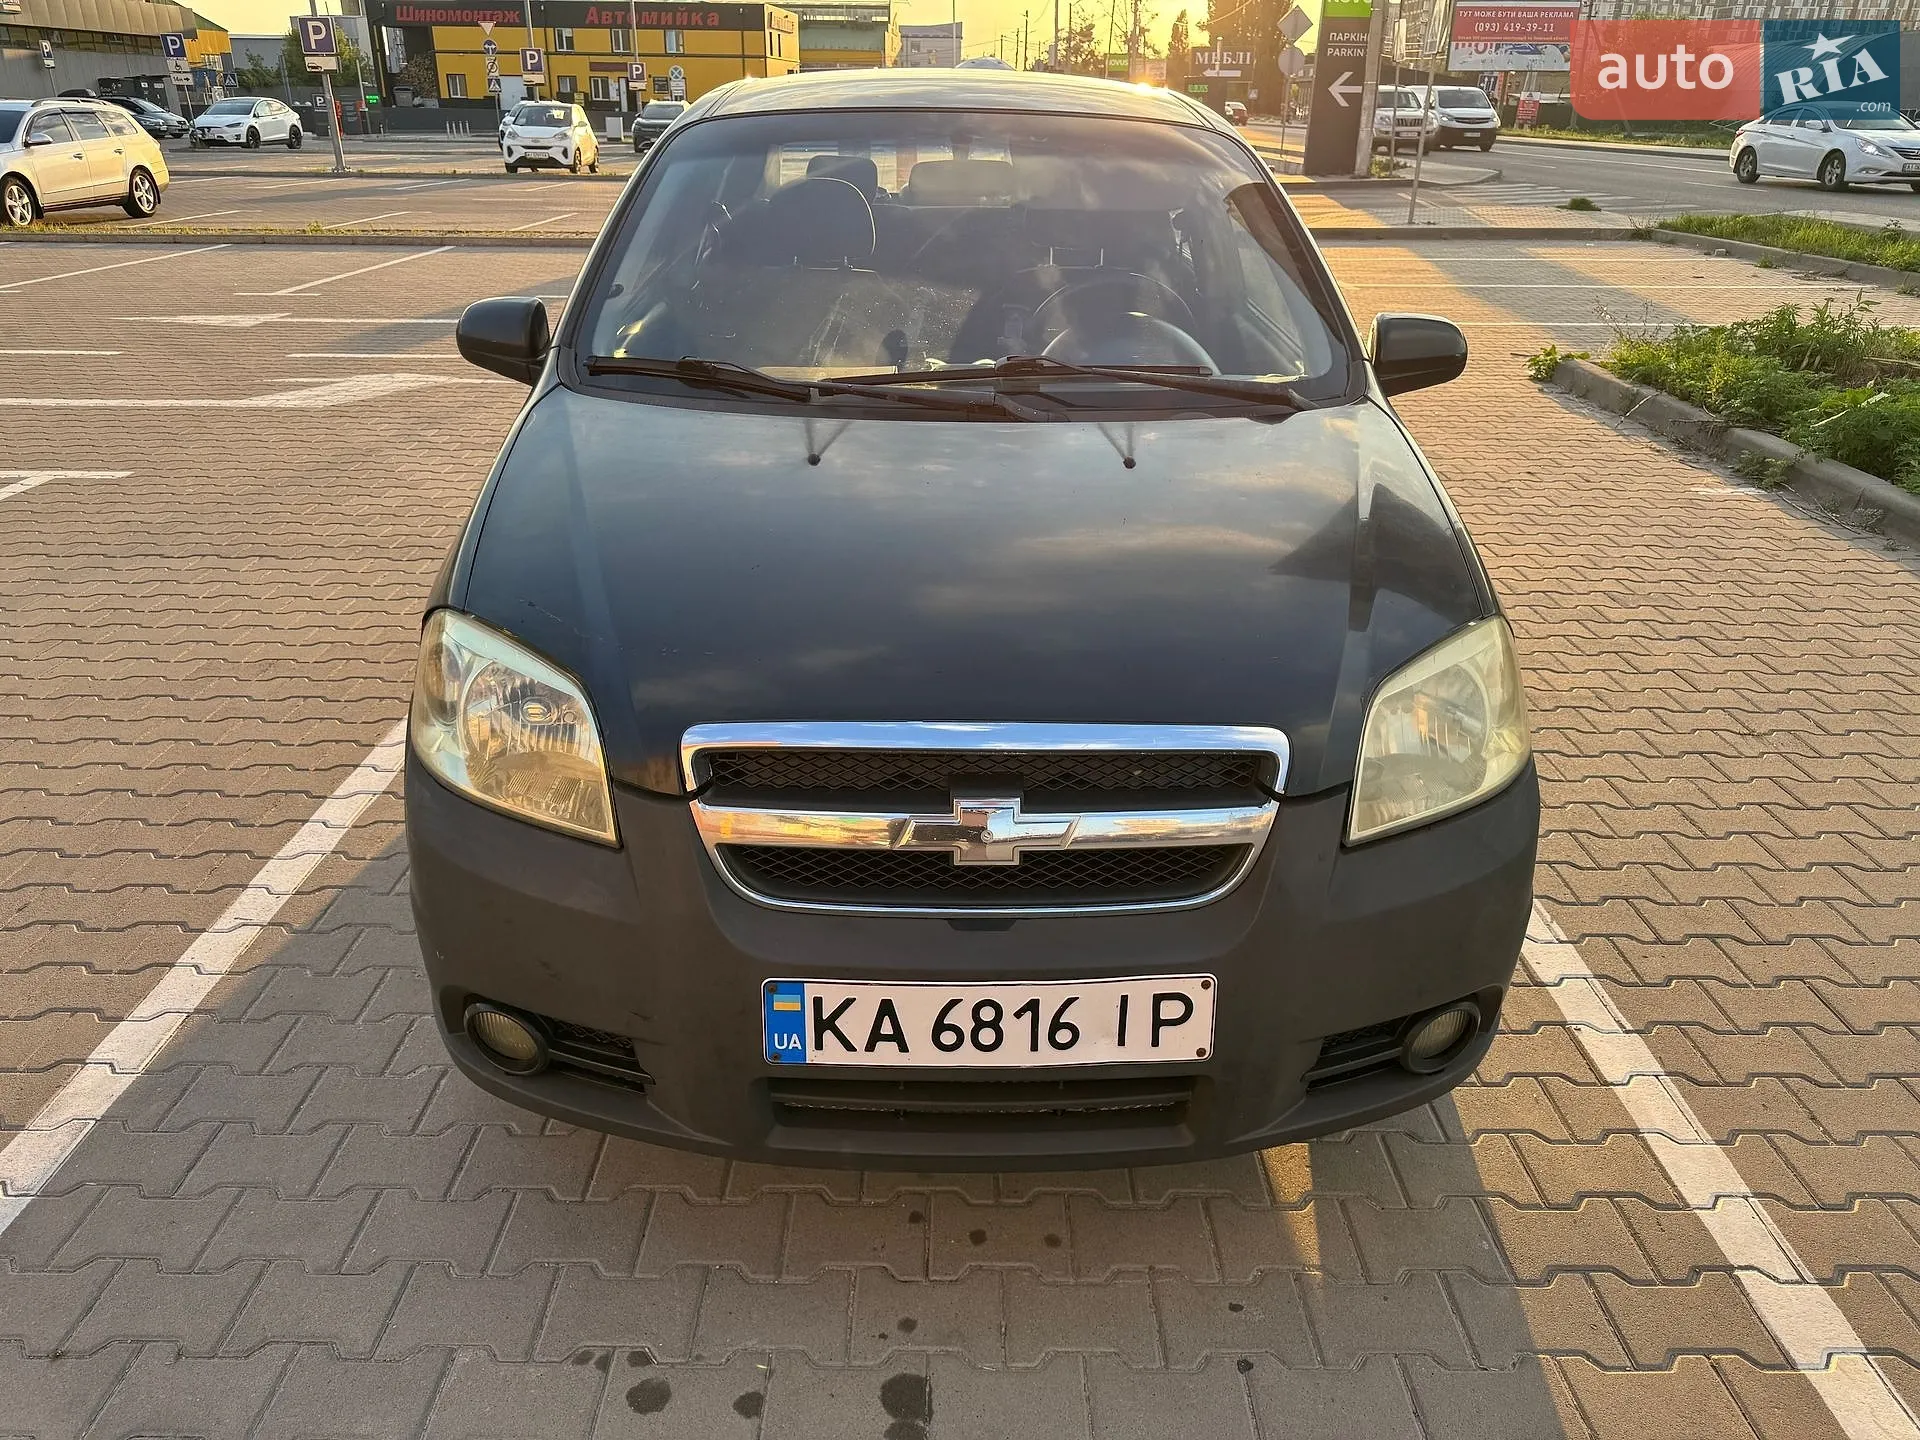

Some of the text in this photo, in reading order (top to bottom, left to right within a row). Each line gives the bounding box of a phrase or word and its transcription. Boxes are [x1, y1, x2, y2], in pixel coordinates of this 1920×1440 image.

[396, 6, 521, 22] Шиномонтаж
[585, 6, 719, 26] Автомийка
[1497, 10, 1516, 18] БУТИ
[307, 21, 326, 49] P
[1474, 22, 1554, 32] (093) 419-39-11
[1329, 32, 1367, 41] ПАРКІН
[167, 36, 180, 55] P
[1327, 48, 1367, 56] PARKIN
[526, 51, 538, 70] P
[1195, 51, 1251, 65] МЕБЛІ
[632, 64, 643, 79] P
[812, 992, 1195, 1053] KA 6816 IP
[774, 1033, 803, 1051] UA
